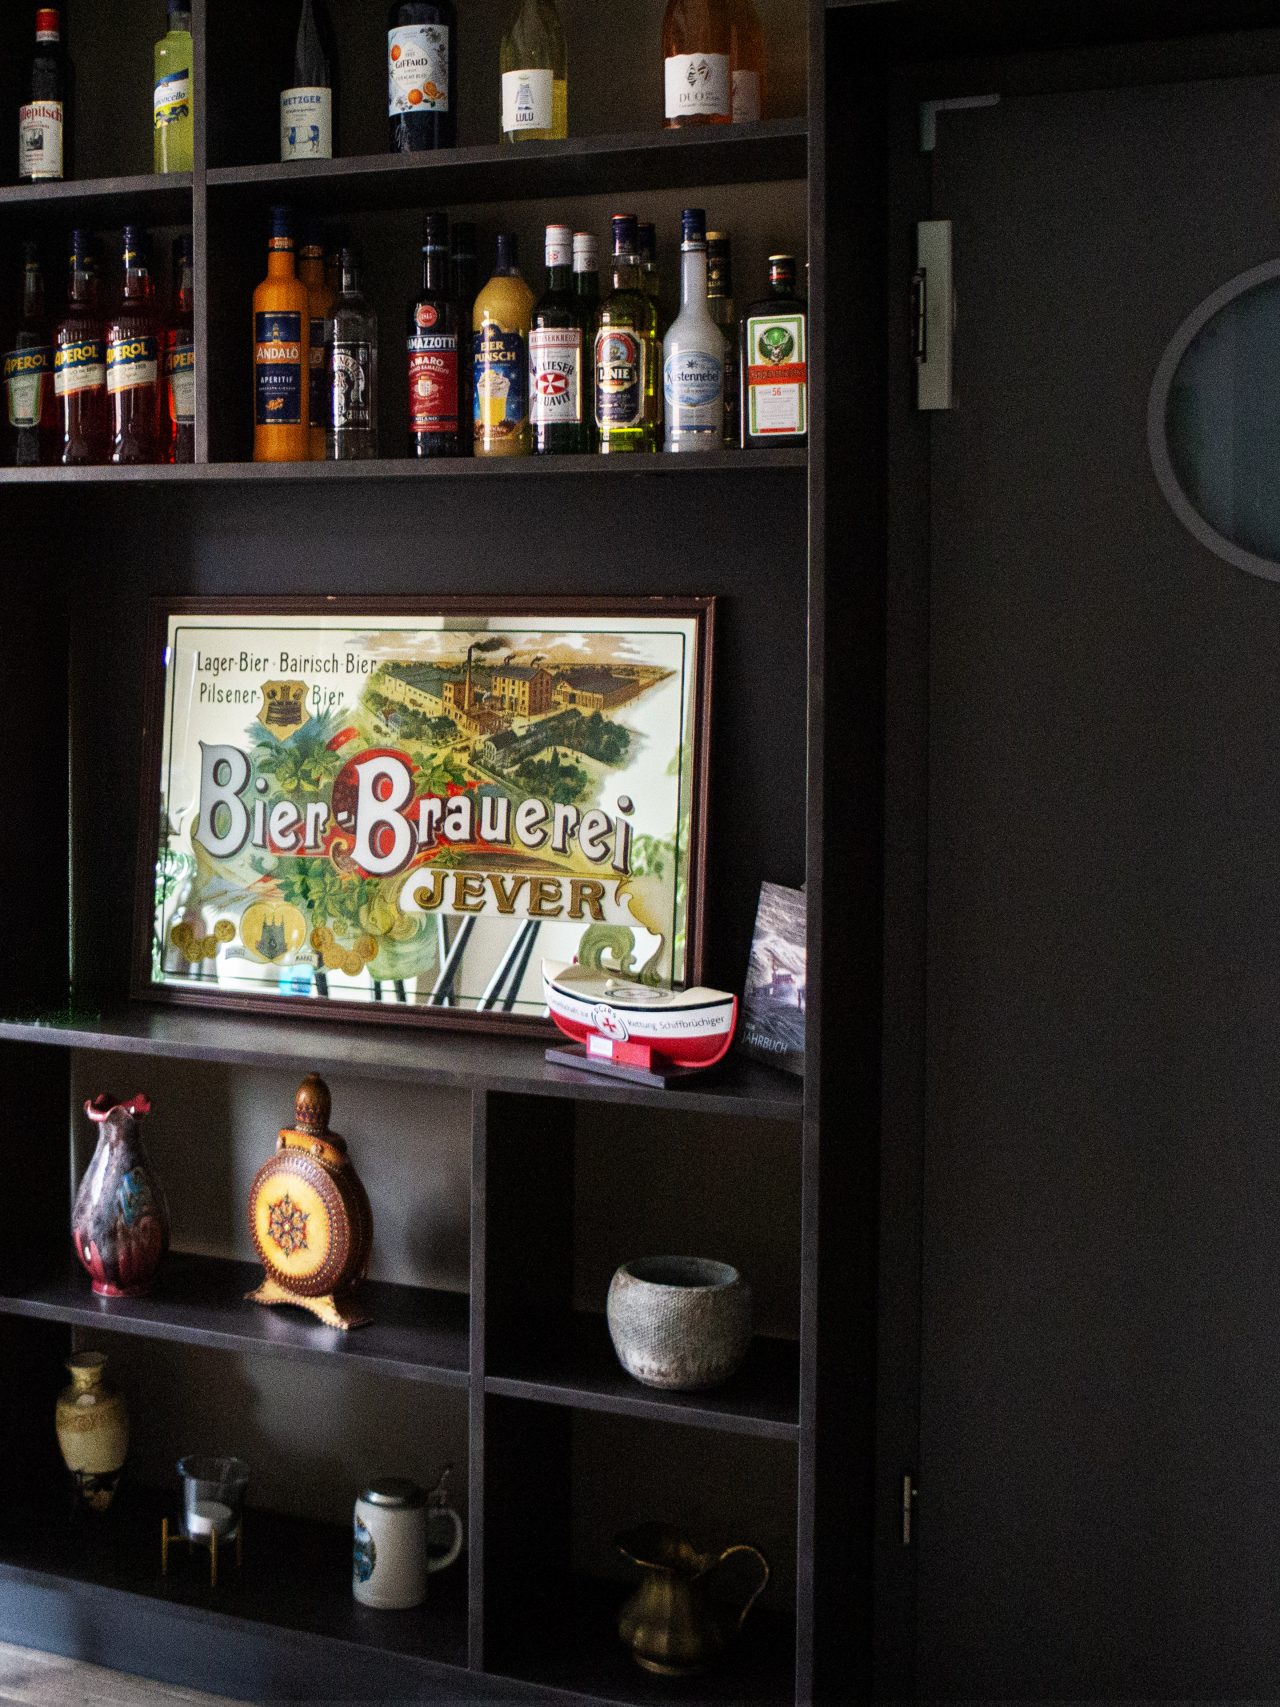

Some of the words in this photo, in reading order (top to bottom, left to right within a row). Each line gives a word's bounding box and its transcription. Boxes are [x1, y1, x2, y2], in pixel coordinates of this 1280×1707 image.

[282, 95, 321, 106] METZGER
[515, 112, 534, 122] LULU
[106, 341, 149, 364] APEROL
[407, 337, 456, 349] AMAZZOTTI
[4, 354, 49, 374] APEROL
[55, 344, 99, 366] APEROL
[167, 351, 195, 370] APER
[410, 356, 444, 368] AMARO
[532, 361, 574, 376] MLTESER
[667, 370, 719, 384] Kstennebel
[197, 651, 269, 676] Lager-Bier
[279, 652, 377, 674] Bairisch-Bier
[312, 685, 345, 706] Bier
[195, 741, 634, 876] Bier-Brauerei
[413, 870, 608, 921] JEVER
[660, 1016, 725, 1030] Schiffbrüchiger
[741, 1031, 788, 1054] JAHRBUCH
